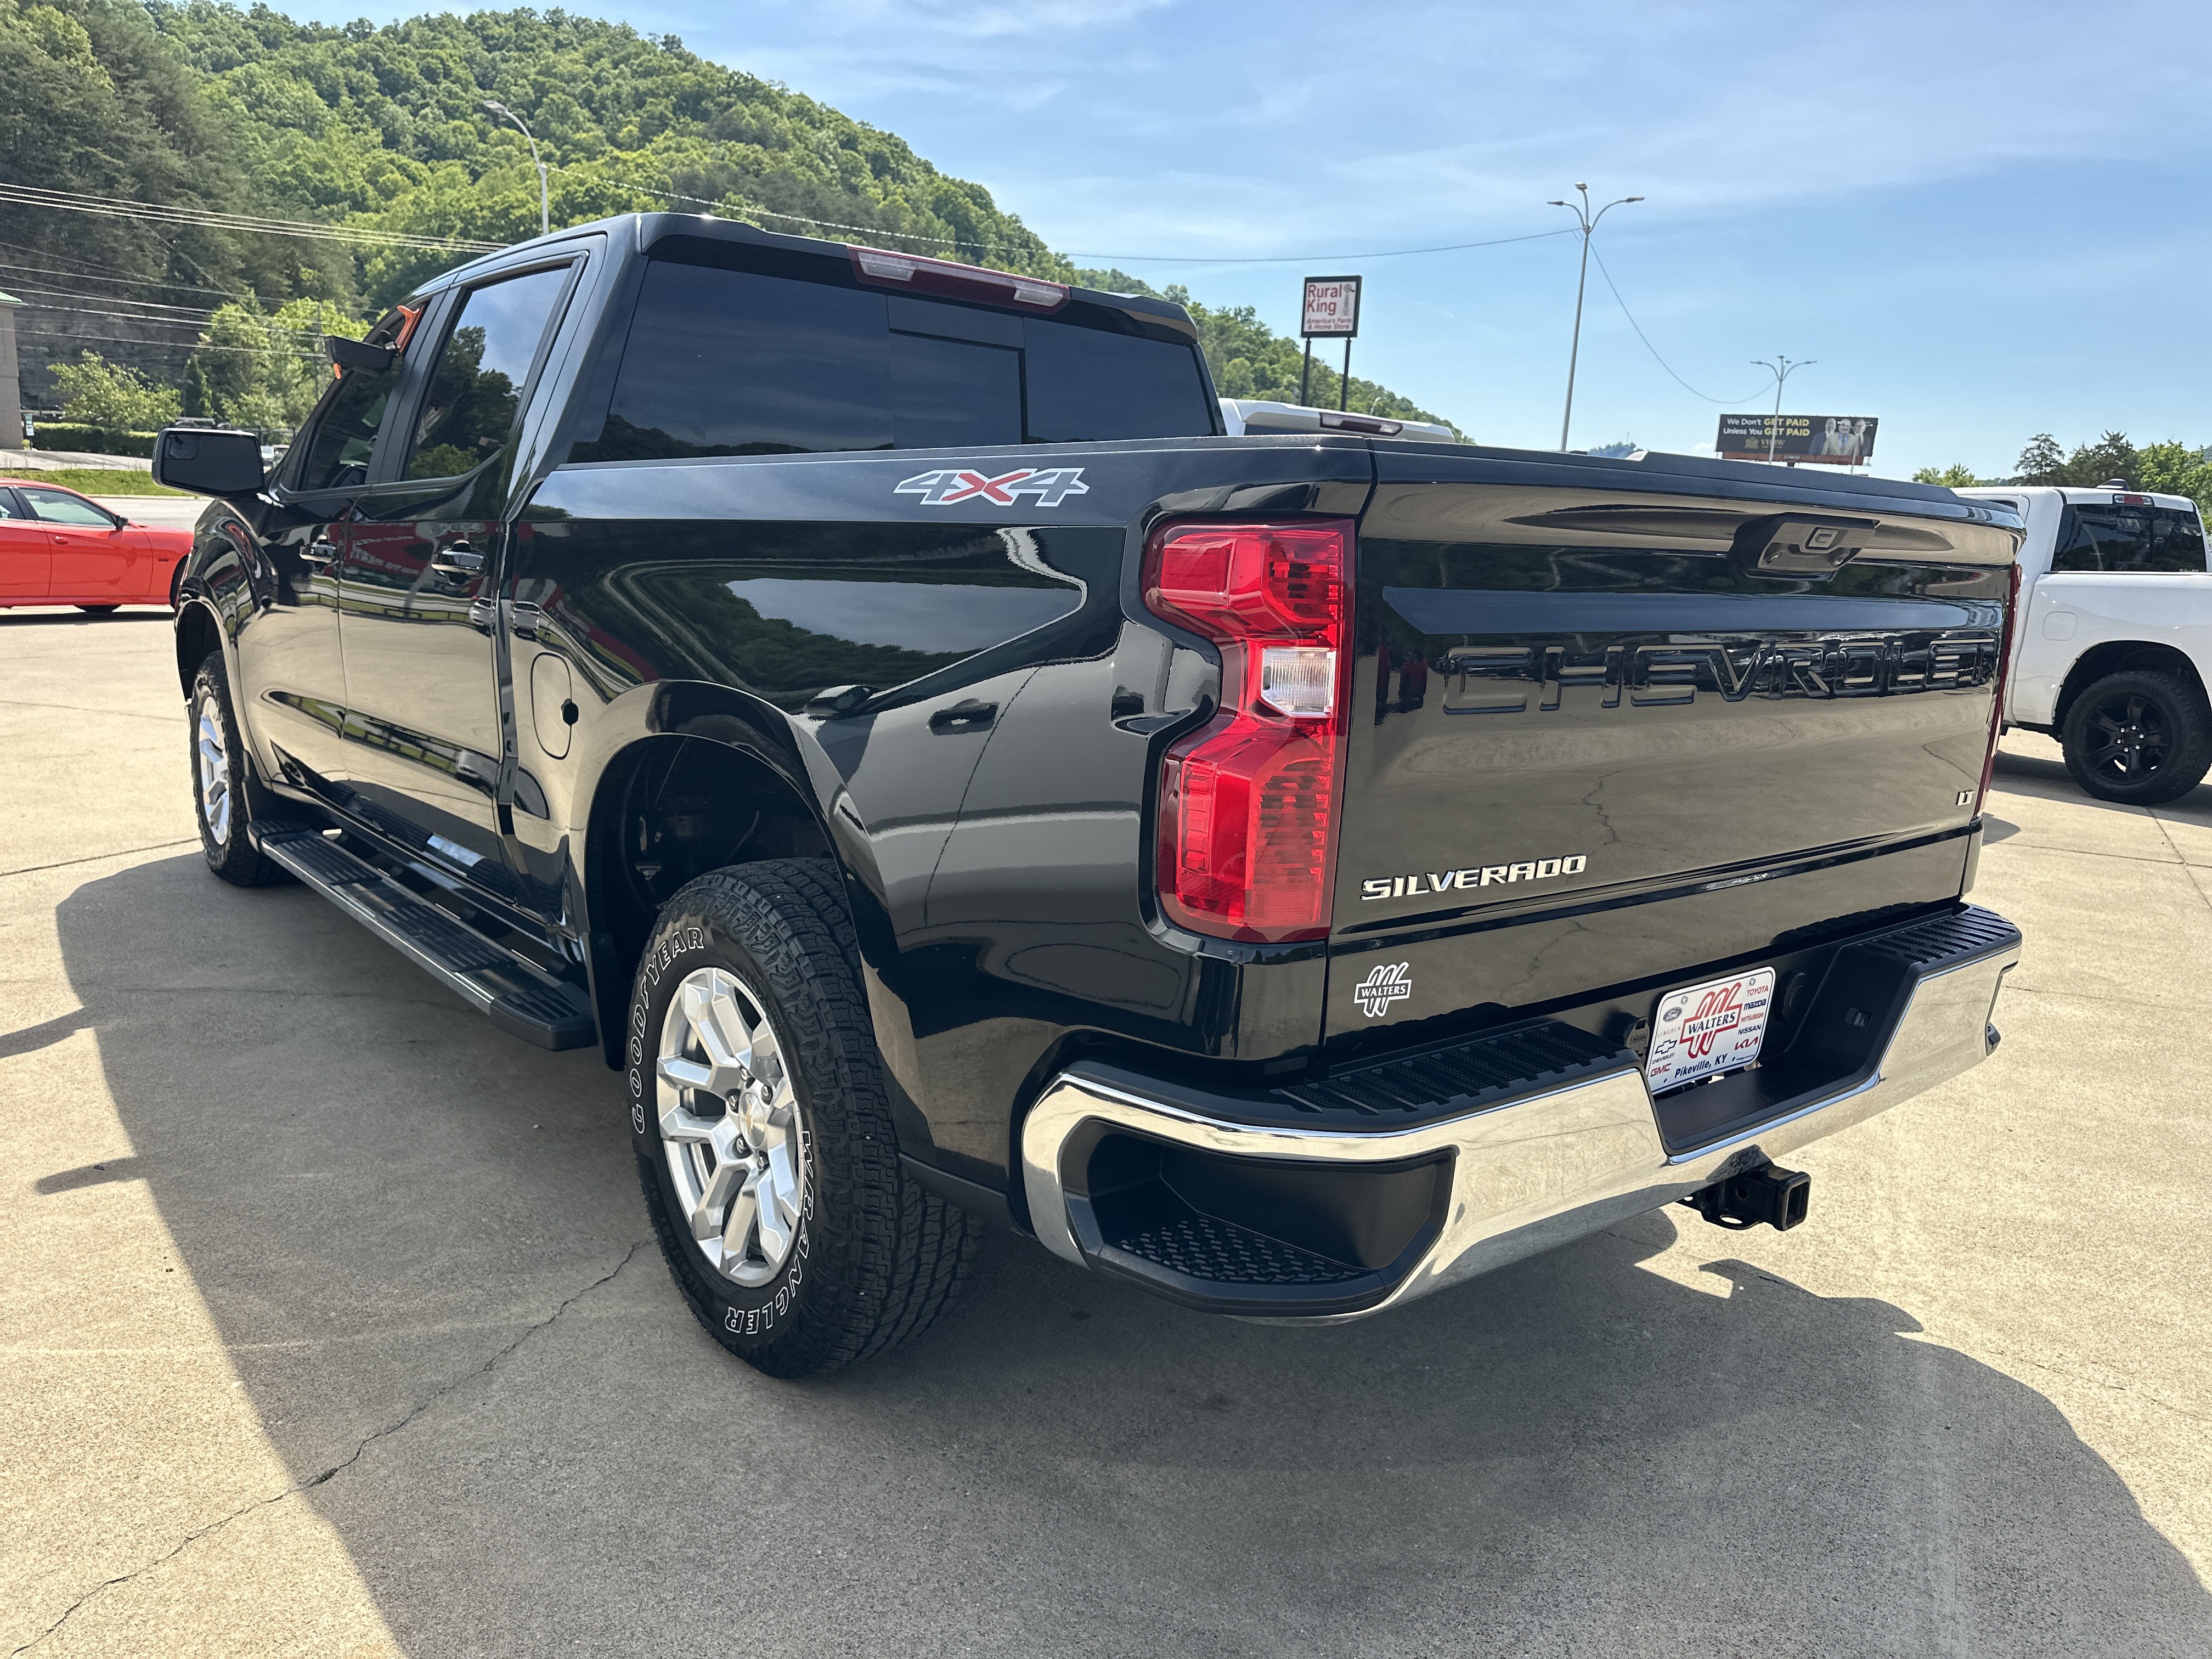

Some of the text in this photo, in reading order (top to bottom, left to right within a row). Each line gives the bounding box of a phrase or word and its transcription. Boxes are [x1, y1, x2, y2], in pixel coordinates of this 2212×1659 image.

[1308, 284, 1342, 298] Rural
[1306, 299, 1337, 316] King
[1786, 428, 1810, 436] PAID
[1443, 637, 1996, 715] CHEVROLET
[1956, 789, 1975, 806] LT
[1360, 854, 1587, 900] SILVERADO
[1361, 985, 1406, 998] WALTERS
[1747, 985, 1769, 997] TOYOTA
[1688, 1012, 1735, 1034] WALTERS
[1740, 1012, 1764, 1023] MITSUBISHI
[630, 927, 704, 1134] GOODYEAR
[1657, 1026, 1681, 1037] LINCOLN
[1737, 1024, 1762, 1035] NISSAN
[1652, 1053, 1675, 1064] CHEVROLET
[1650, 1063, 1672, 1077] GMC
[1674, 1053, 1728, 1079] Pikeville, KY
[725, 1131, 814, 1334] WRANGLER
